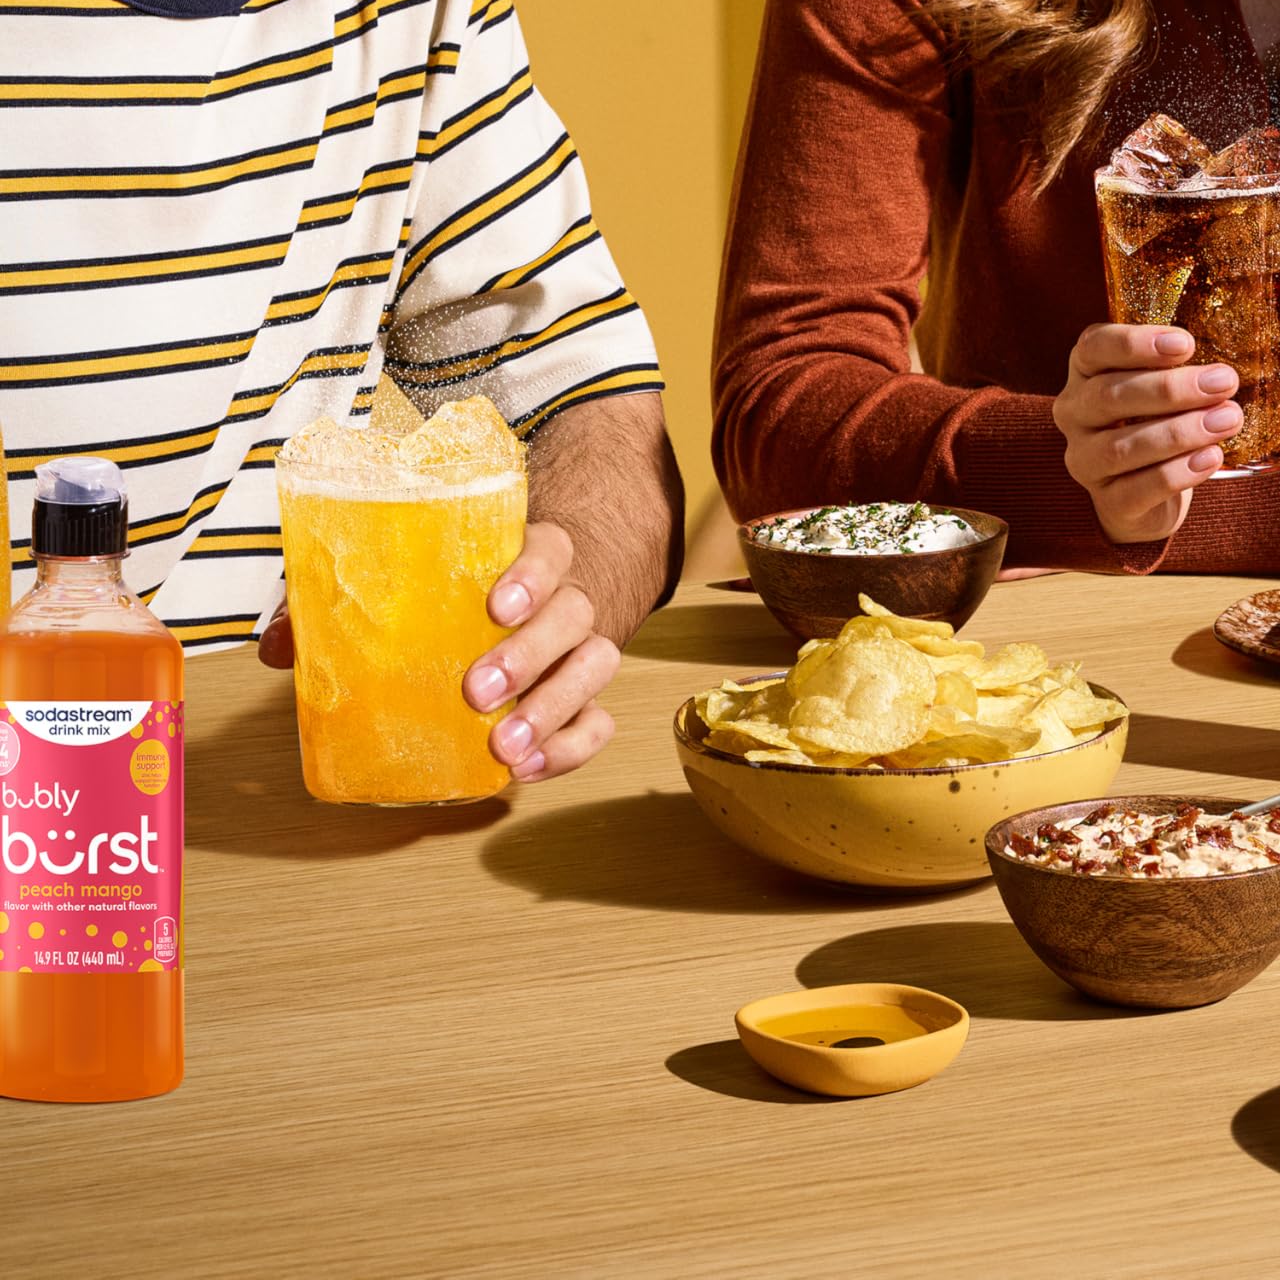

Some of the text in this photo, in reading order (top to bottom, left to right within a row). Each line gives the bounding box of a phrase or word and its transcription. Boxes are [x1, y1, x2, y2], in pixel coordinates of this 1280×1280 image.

[25, 707, 131, 722] sodastream
[49, 724, 110, 736] drink mix
[0, 743, 8, 759] 4
[136, 763, 165, 772] support
[2, 782, 80, 817] bubly
[19, 882, 143, 901] peach mango
[4, 901, 158, 911] flavor with other natural flavors
[163, 922, 169, 936] 5
[34, 950, 124, 966] 14.9 FL OZ (440 mL)
